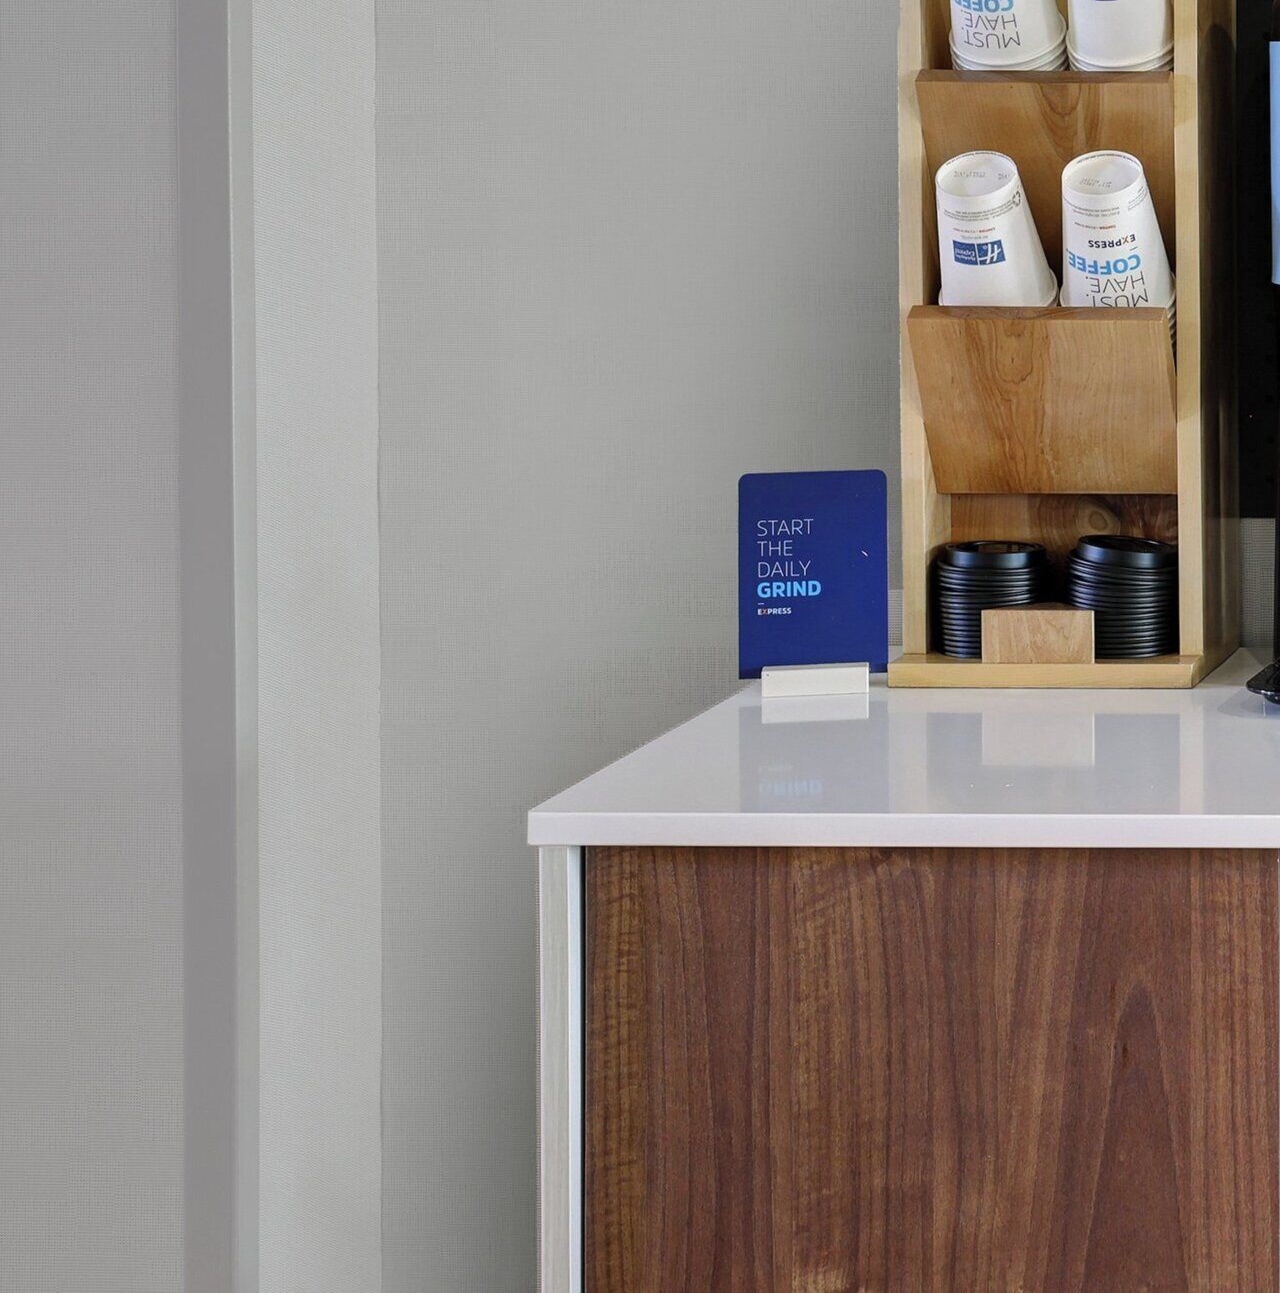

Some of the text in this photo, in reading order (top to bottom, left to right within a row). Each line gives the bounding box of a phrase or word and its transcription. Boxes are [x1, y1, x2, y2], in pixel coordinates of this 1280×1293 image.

[961, 9, 1018, 31] HAVE.
[961, 26, 1021, 49] MUST.
[1088, 234, 1137, 249] EXPRESS
[1065, 247, 1142, 276] COFFEE.
[1085, 271, 1146, 294] HAVE.
[756, 518, 815, 537] START
[756, 539, 794, 557] THE
[757, 559, 812, 579] DAILY
[756, 580, 822, 599] GRIND
[757, 607, 792, 616] EXPRESS
